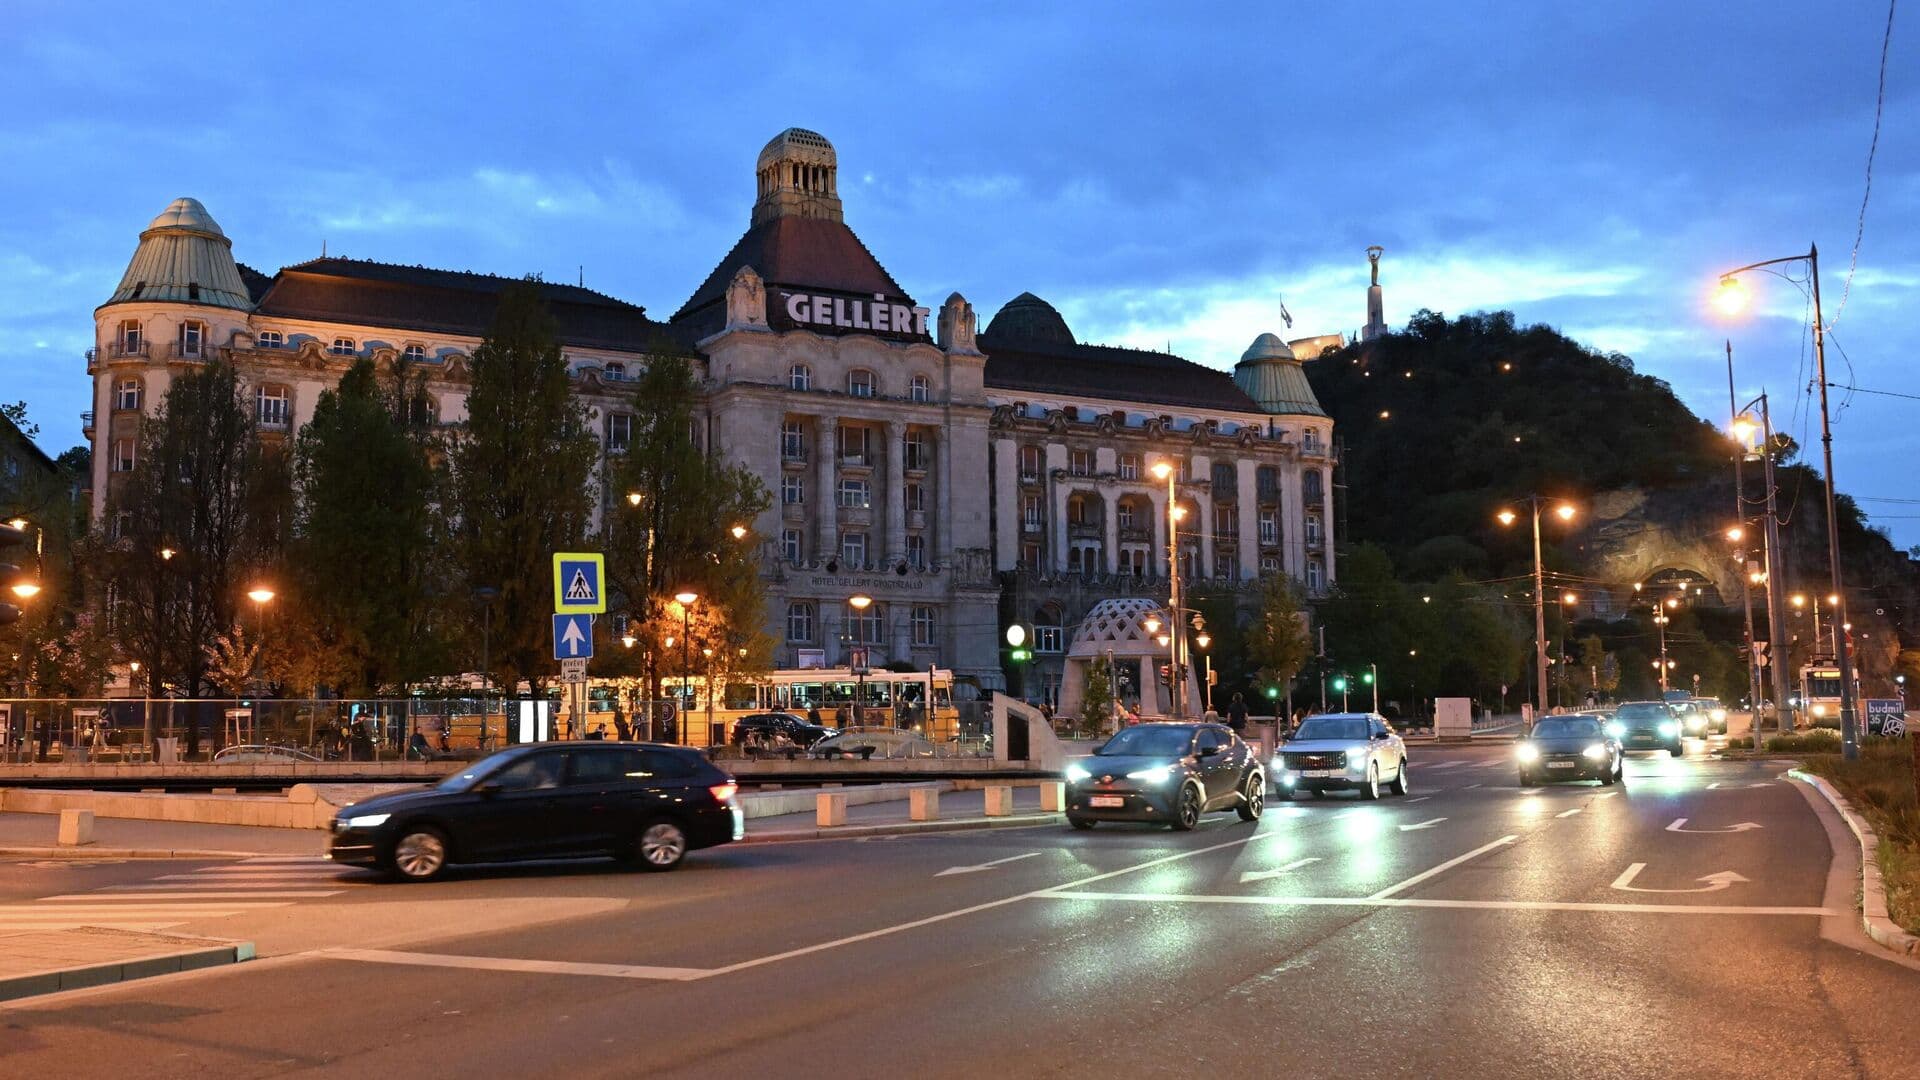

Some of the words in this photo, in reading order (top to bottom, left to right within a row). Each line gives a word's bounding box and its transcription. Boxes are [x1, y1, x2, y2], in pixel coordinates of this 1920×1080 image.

[811, 576, 835, 586] HOTEL
[1868, 702, 1902, 713] budmil
[1869, 714, 1881, 725] 35
